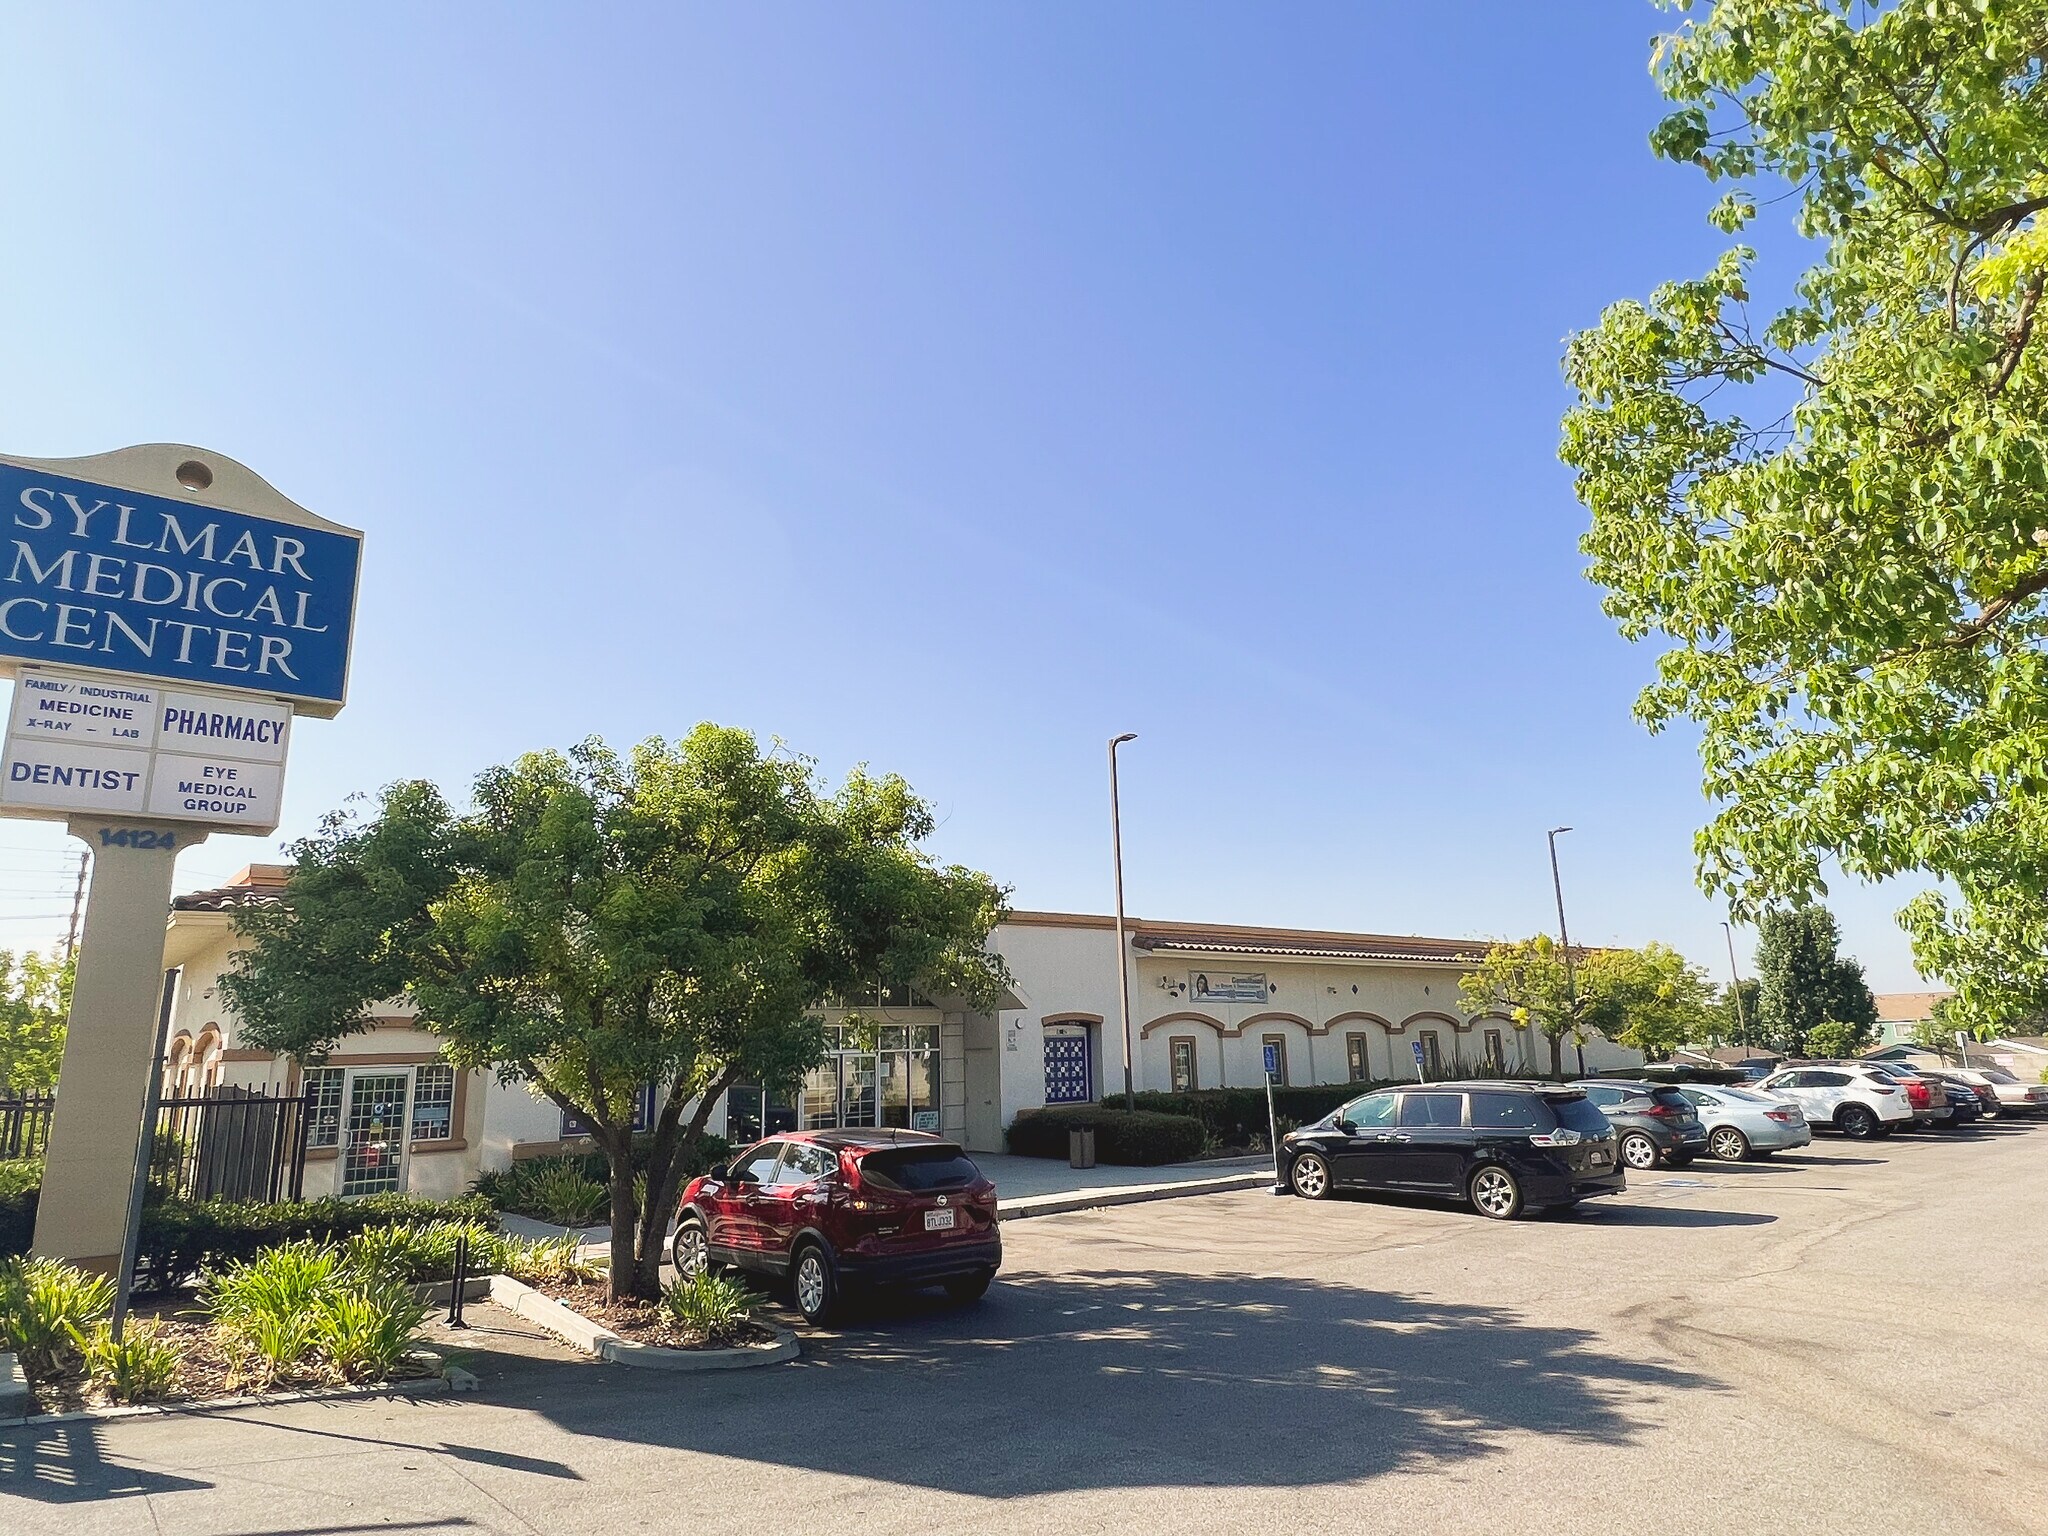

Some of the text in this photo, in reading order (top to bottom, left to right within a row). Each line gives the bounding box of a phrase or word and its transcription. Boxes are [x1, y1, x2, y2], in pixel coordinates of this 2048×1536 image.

[14, 487, 313, 581] SYLMAR
[3, 540, 328, 633] MEDICAL
[0, 598, 300, 681] CENTER
[80, 686, 152, 703] INDUSTRIAL
[39, 699, 134, 720] MEDICINE
[26, 718, 72, 731] X-RAY
[112, 727, 140, 739] LAB
[163, 707, 285, 745] PHARMACY
[11, 762, 140, 791] DENTIST
[203, 766, 238, 780] EYE
[178, 782, 257, 799] MEDICAL
[184, 798, 247, 814] GROUP
[98, 828, 176, 850] 14124
